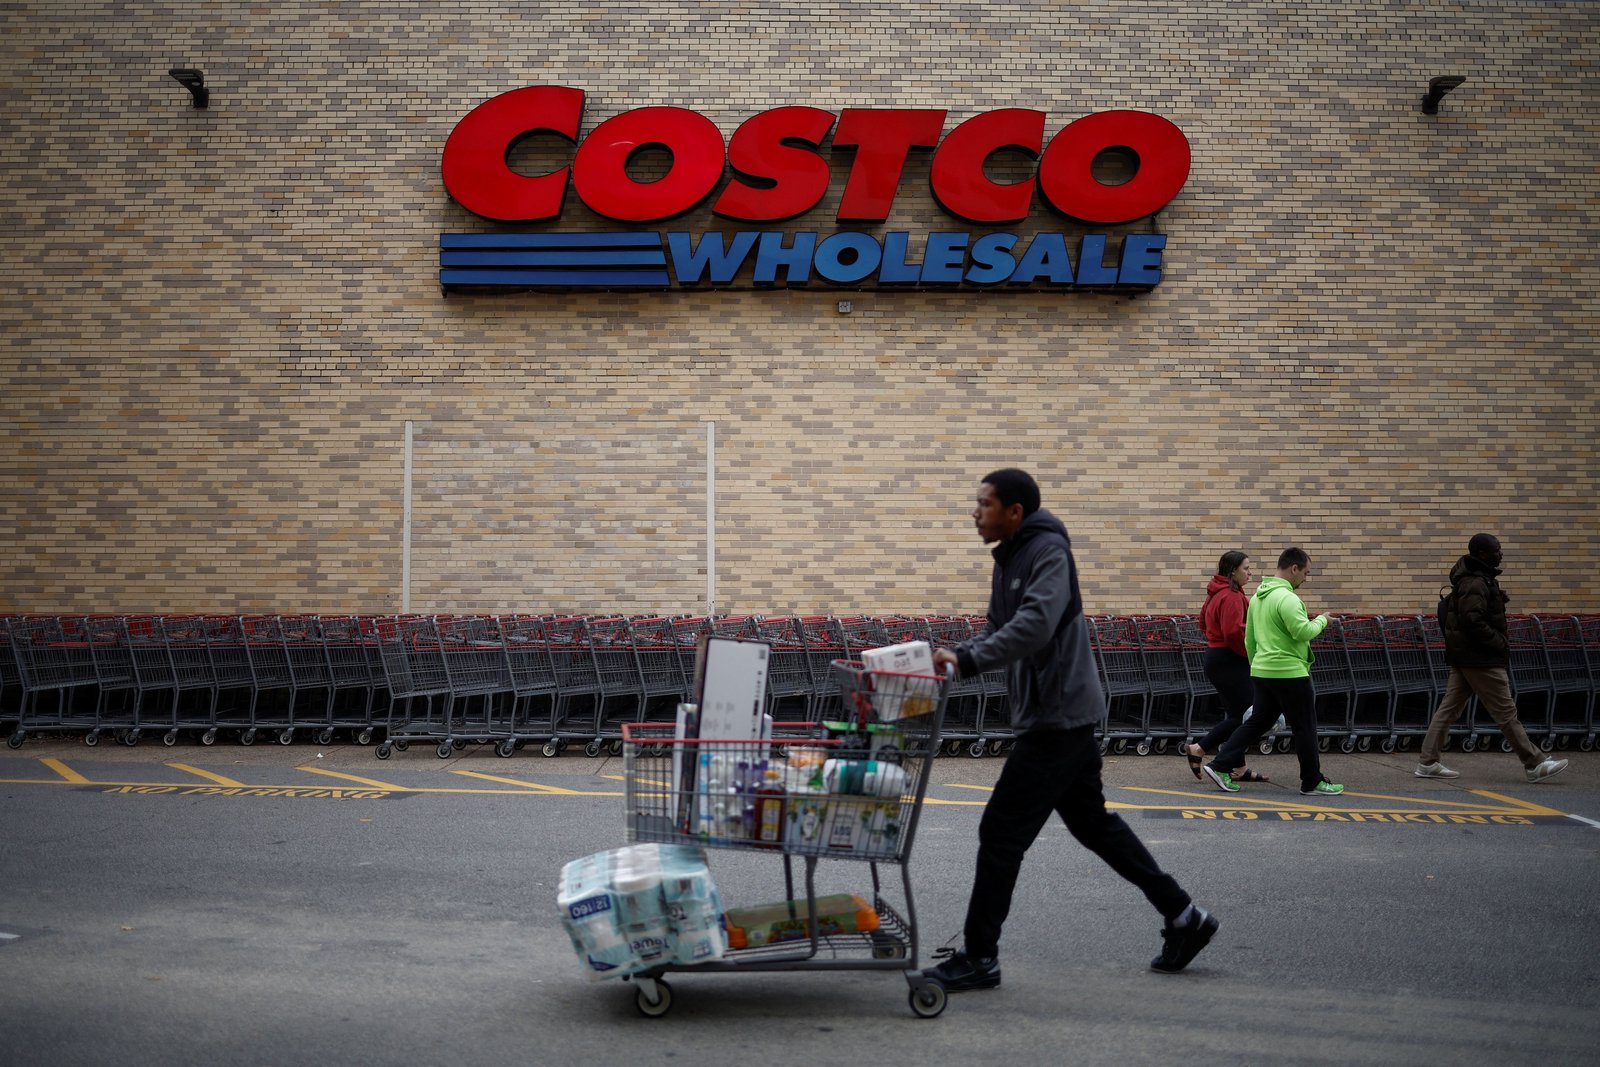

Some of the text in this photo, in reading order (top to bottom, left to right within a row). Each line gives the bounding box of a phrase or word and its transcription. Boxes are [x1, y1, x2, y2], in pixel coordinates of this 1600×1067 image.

[441, 85, 1191, 225] COSTCO
[666, 231, 1167, 286] WHOLESALE
[102, 786, 391, 798] NO PARKING
[1181, 809, 1535, 825] NO PARKING
[572, 902, 593, 918] 160
[630, 936, 670, 954] Towel
